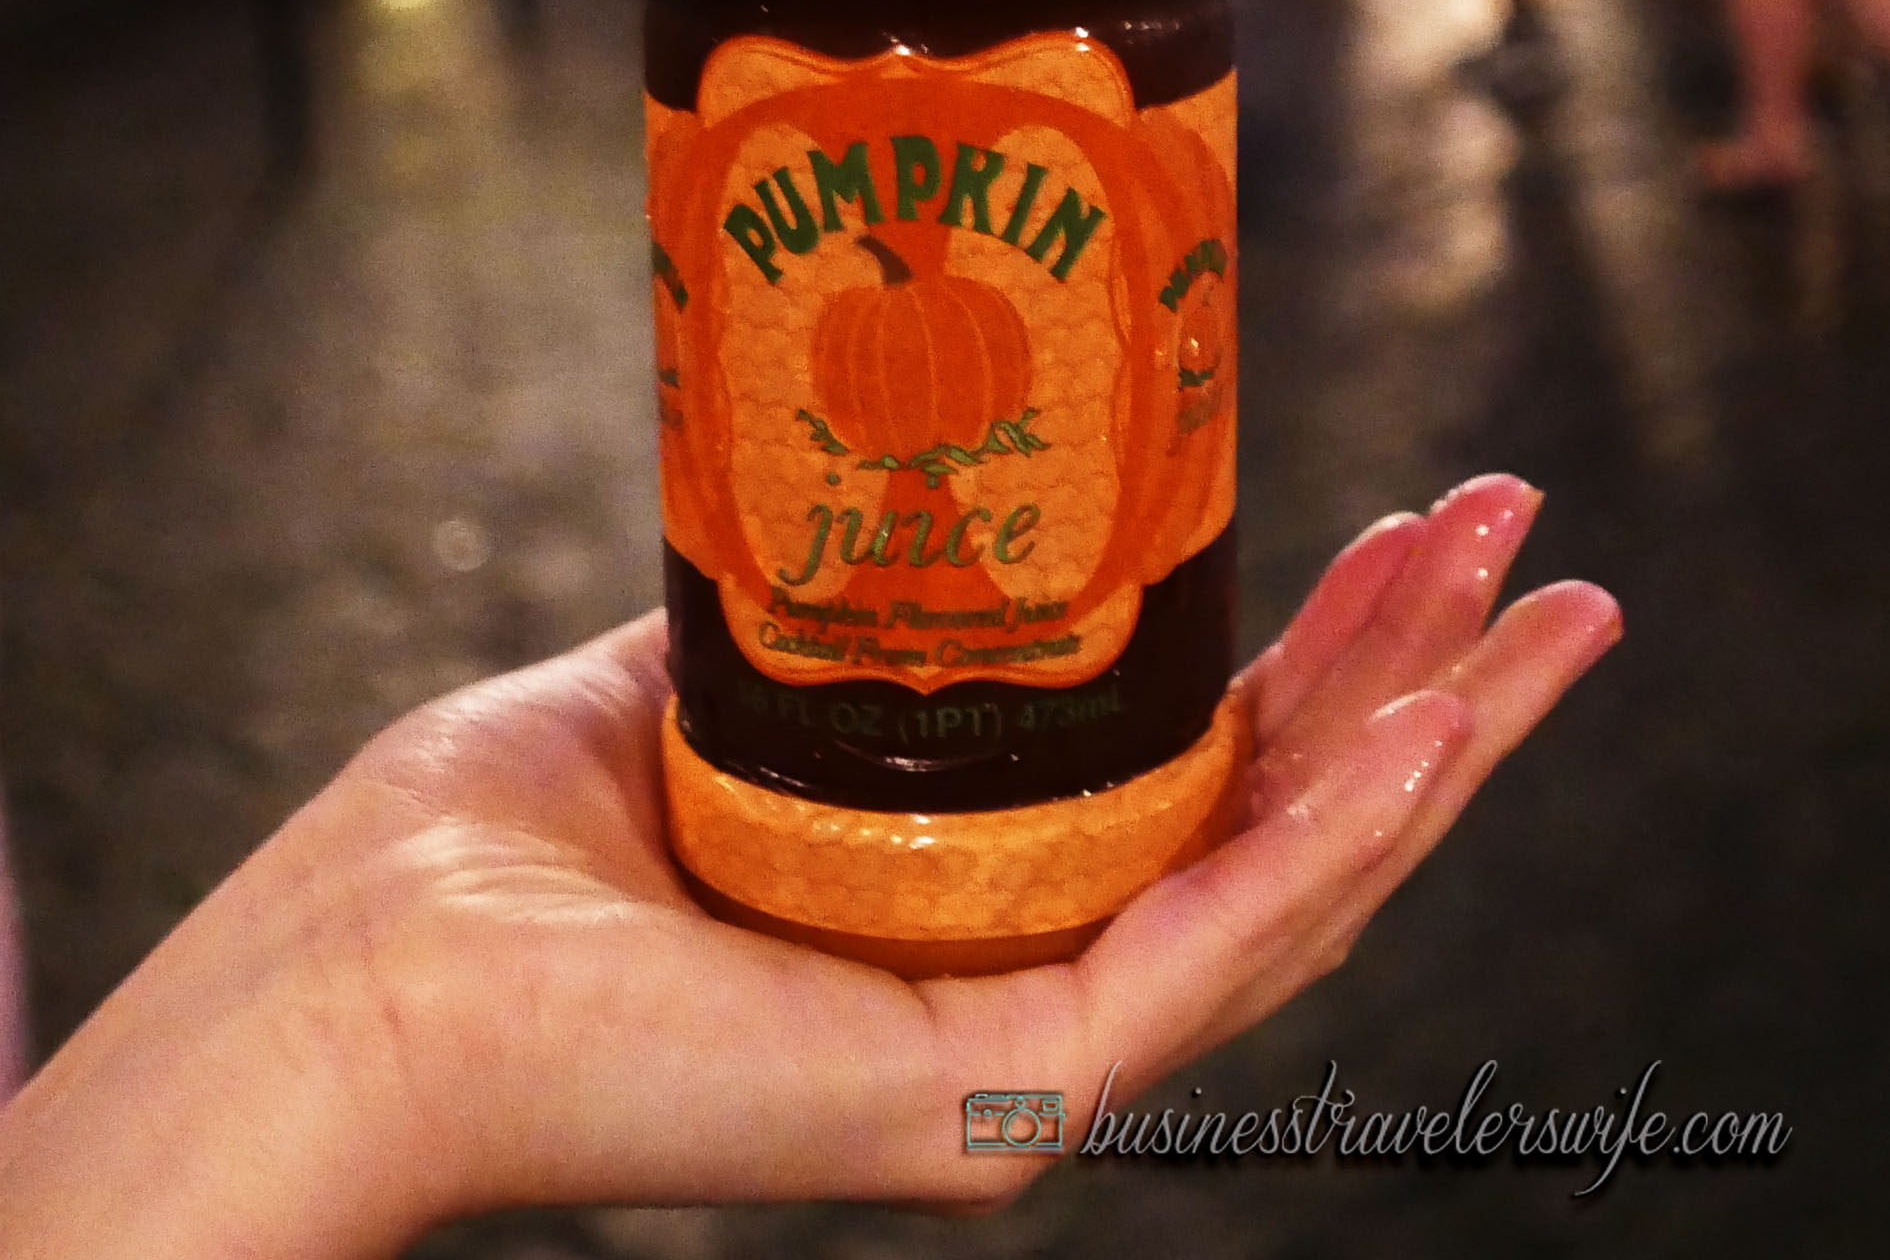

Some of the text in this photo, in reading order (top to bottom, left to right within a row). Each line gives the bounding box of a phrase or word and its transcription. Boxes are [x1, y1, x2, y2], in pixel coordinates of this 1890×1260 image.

[723, 134, 1107, 286] PUMPKIN
[777, 471, 1043, 587] juice
[829, 701, 886, 738] OZ
